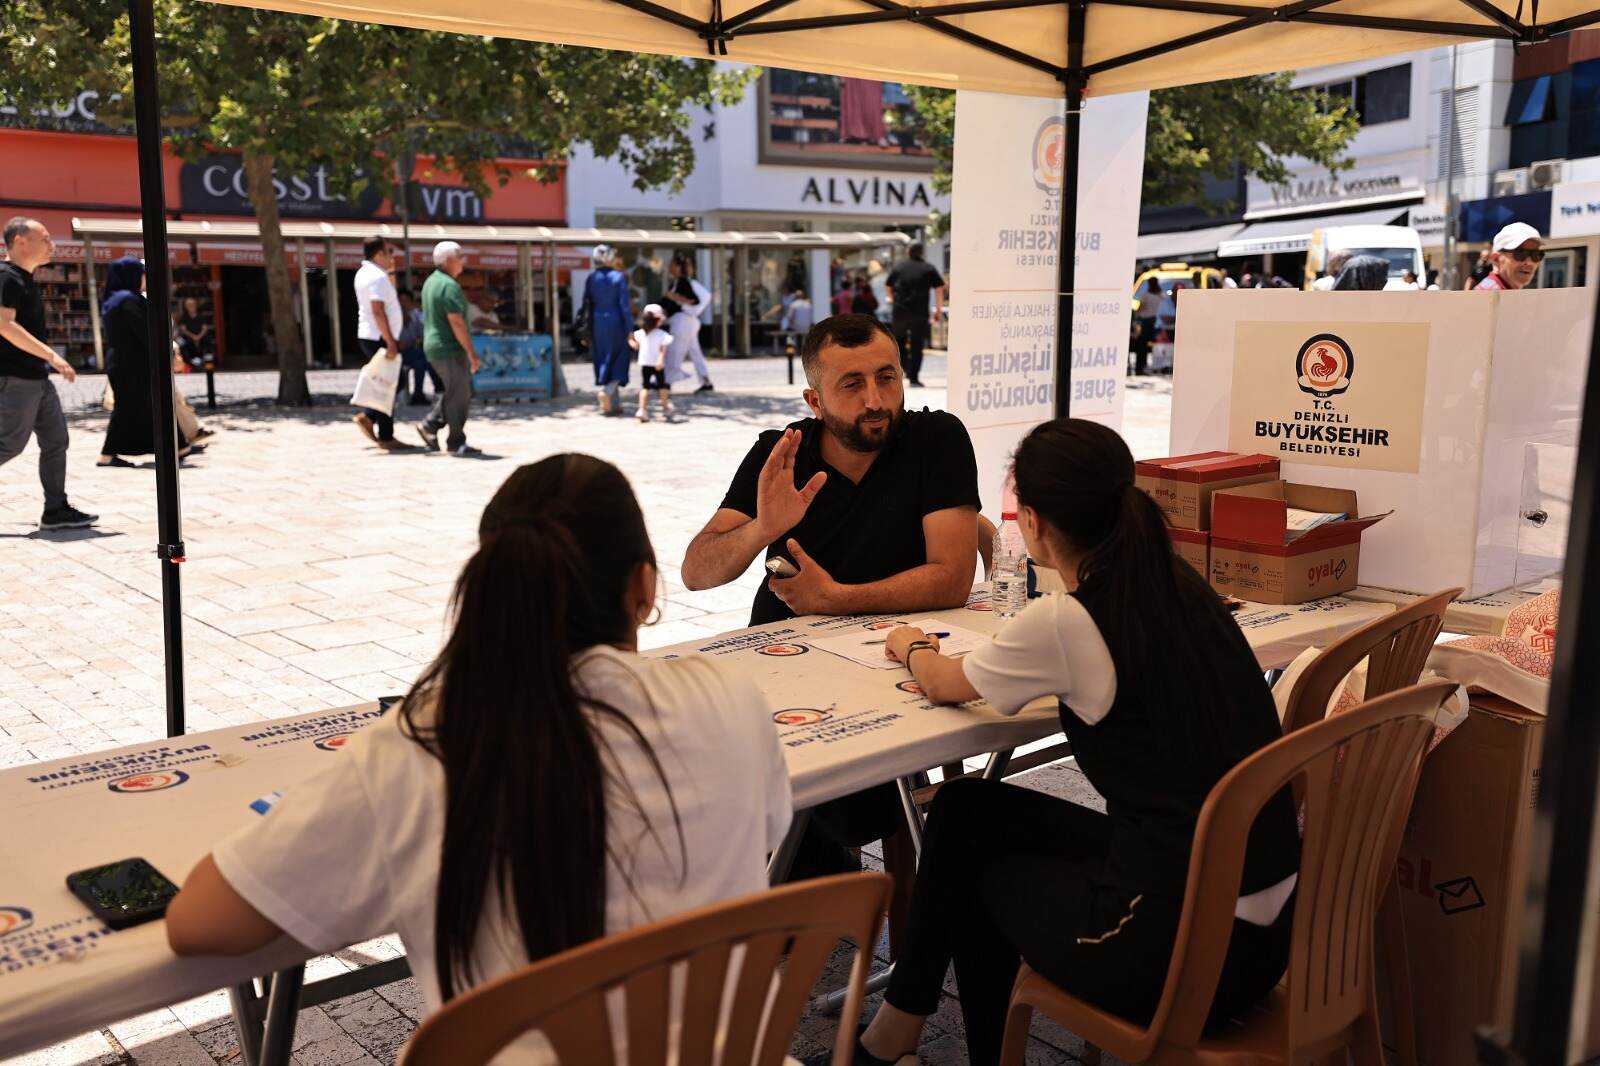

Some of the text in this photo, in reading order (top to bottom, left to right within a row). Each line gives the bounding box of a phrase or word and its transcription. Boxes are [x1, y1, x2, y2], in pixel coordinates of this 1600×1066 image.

[1312, 400, 1335, 410] T.C.
[1294, 411, 1349, 424] DENİZLİ
[1255, 420, 1389, 446] BÜYÜKŞEHİR
[1280, 441, 1361, 457] BELEDİYESİ
